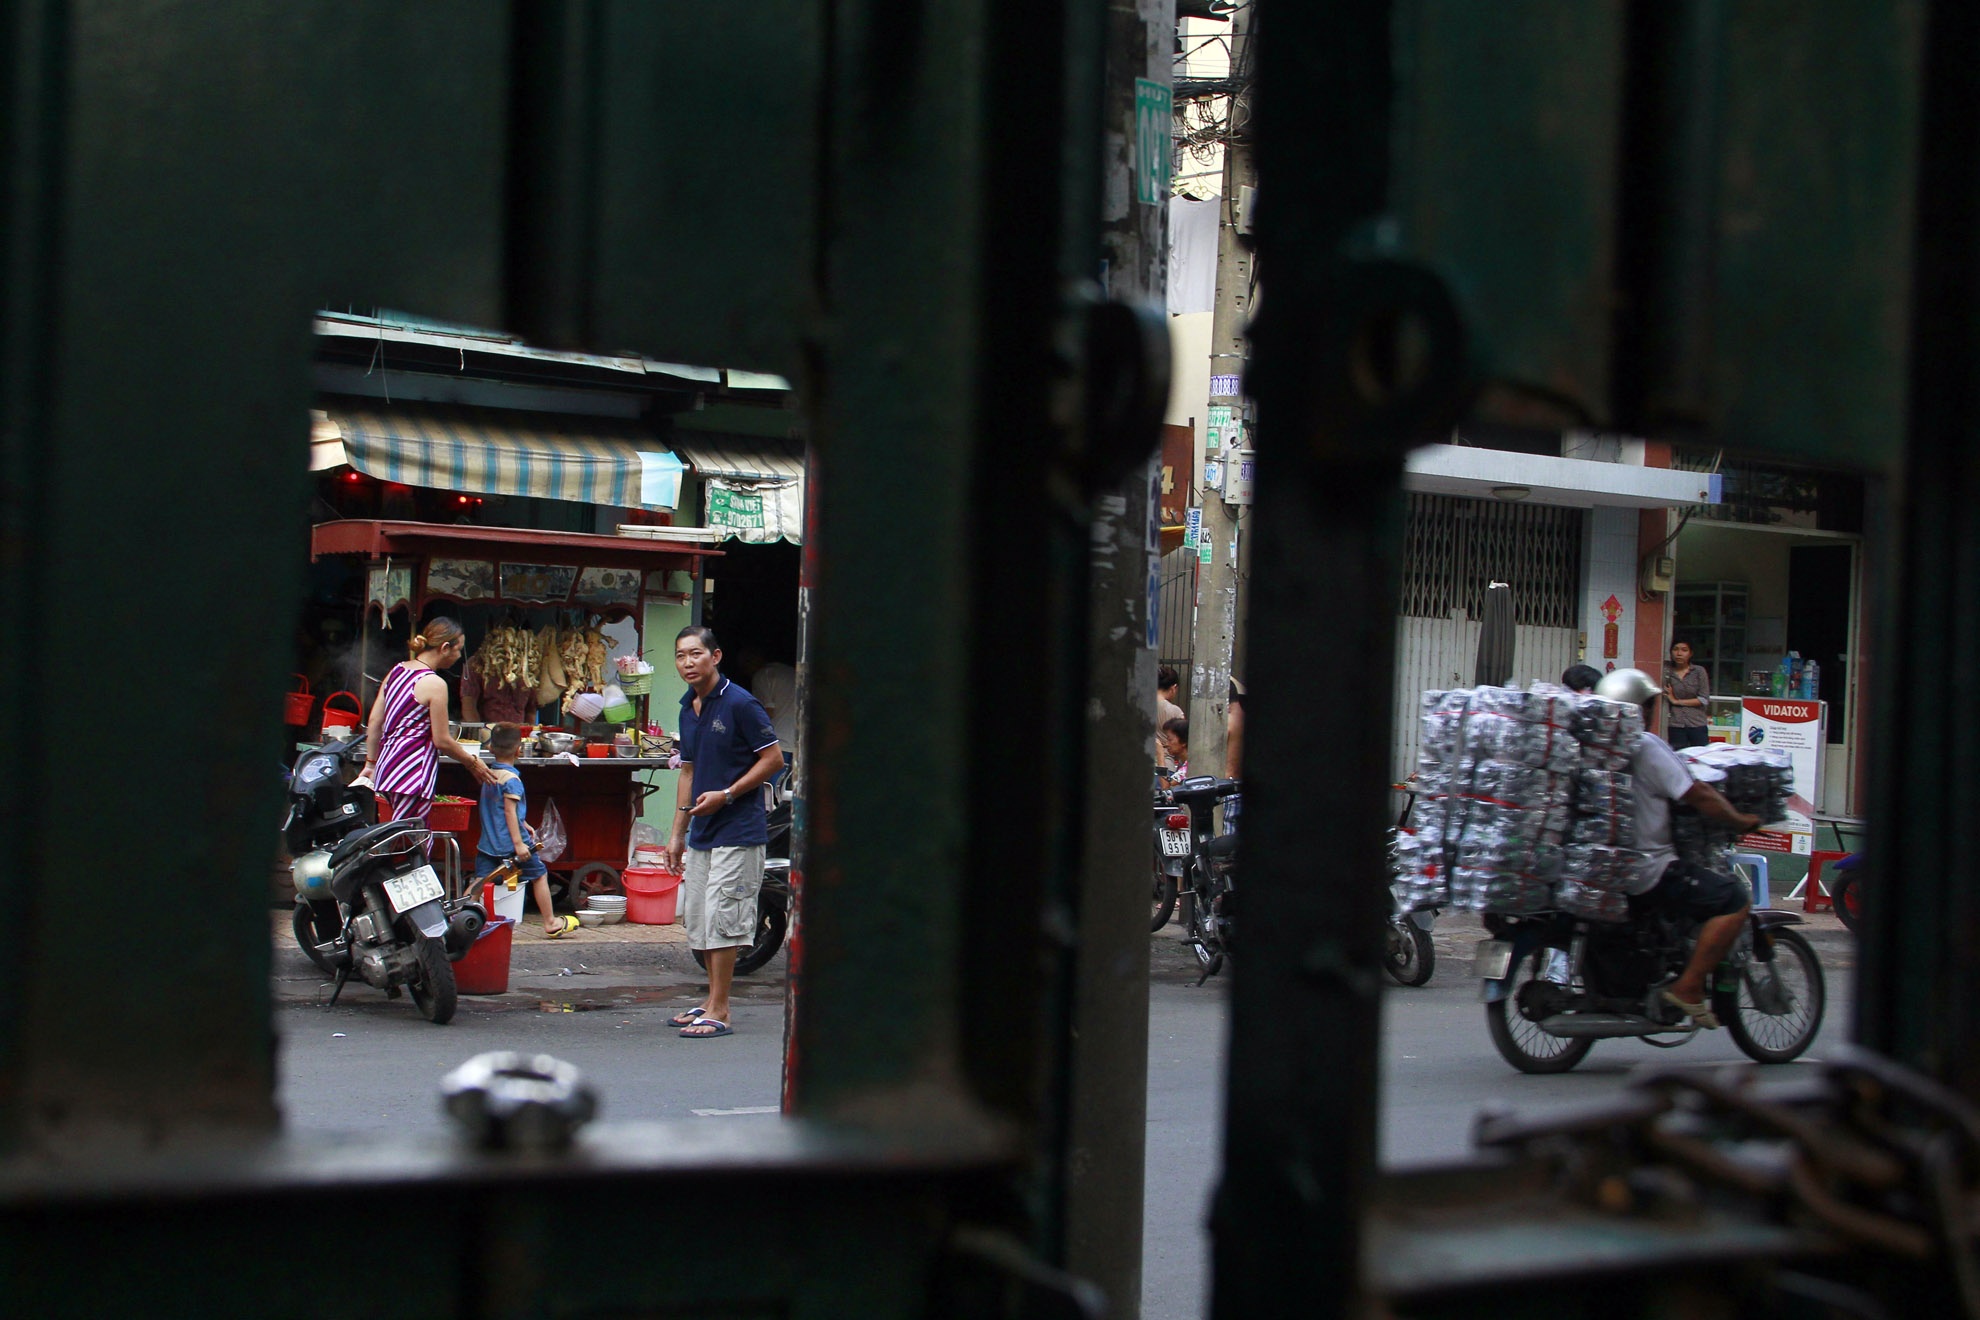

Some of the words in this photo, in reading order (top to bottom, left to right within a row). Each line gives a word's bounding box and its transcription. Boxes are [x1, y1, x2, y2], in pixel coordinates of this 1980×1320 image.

[1763, 704, 1808, 718] VIDATOX
[1168, 843, 1190, 854] 9518
[400, 884, 436, 908] 4125
